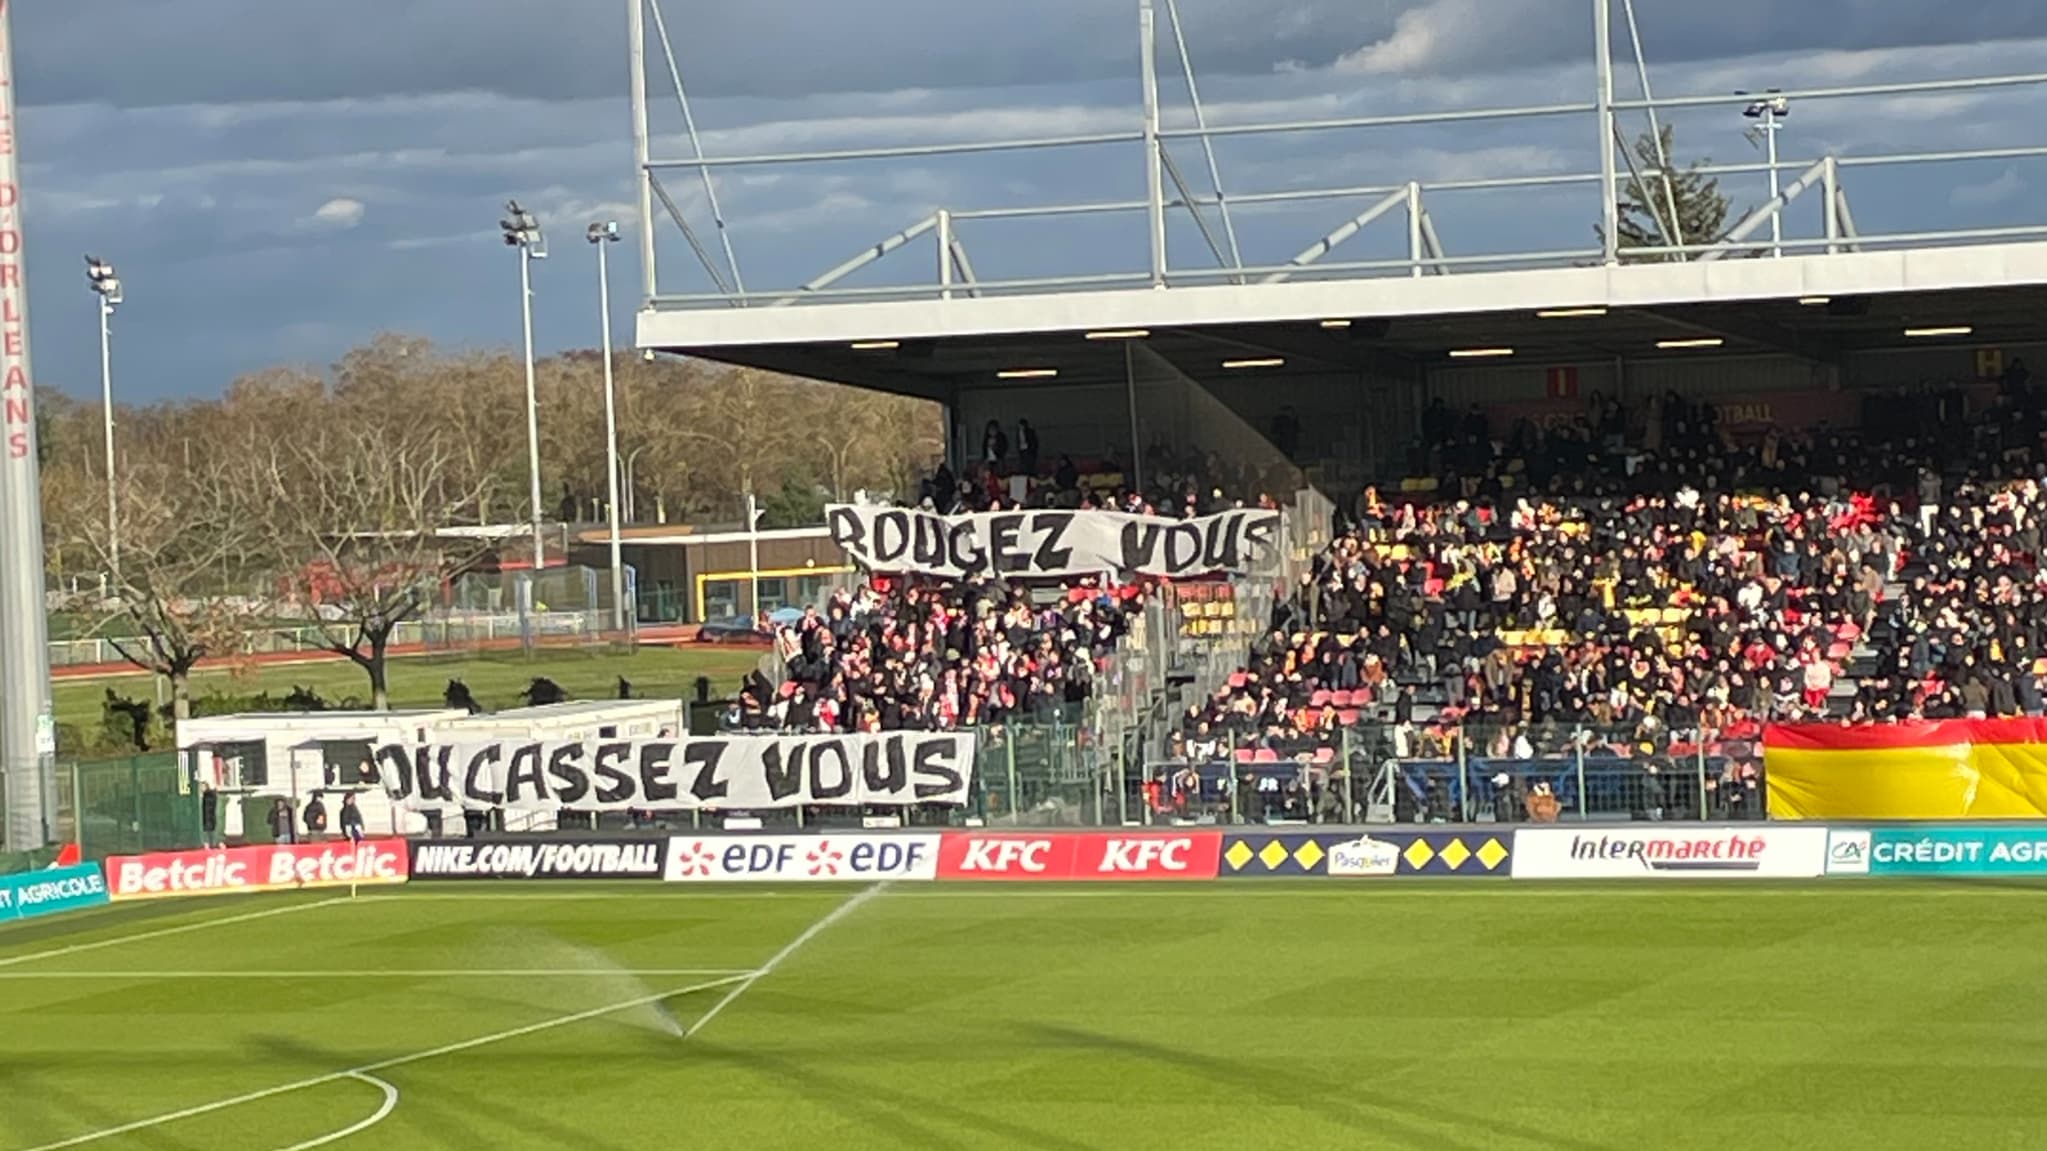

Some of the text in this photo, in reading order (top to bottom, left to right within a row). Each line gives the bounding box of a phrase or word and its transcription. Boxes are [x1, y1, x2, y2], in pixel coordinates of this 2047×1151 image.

[1120, 513, 1281, 573] VOUS
[763, 736, 964, 802] VOUS
[269, 843, 399, 885] Betclic
[414, 843, 659, 876] NIKE.COM/FOOTBALL
[960, 839, 1052, 871] KFC
[1099, 838, 1191, 871] KFC
[1873, 838, 1984, 862] CRÉDIT
[18, 874, 104, 906] AGRICOLE
[118, 854, 247, 894] Betclic
